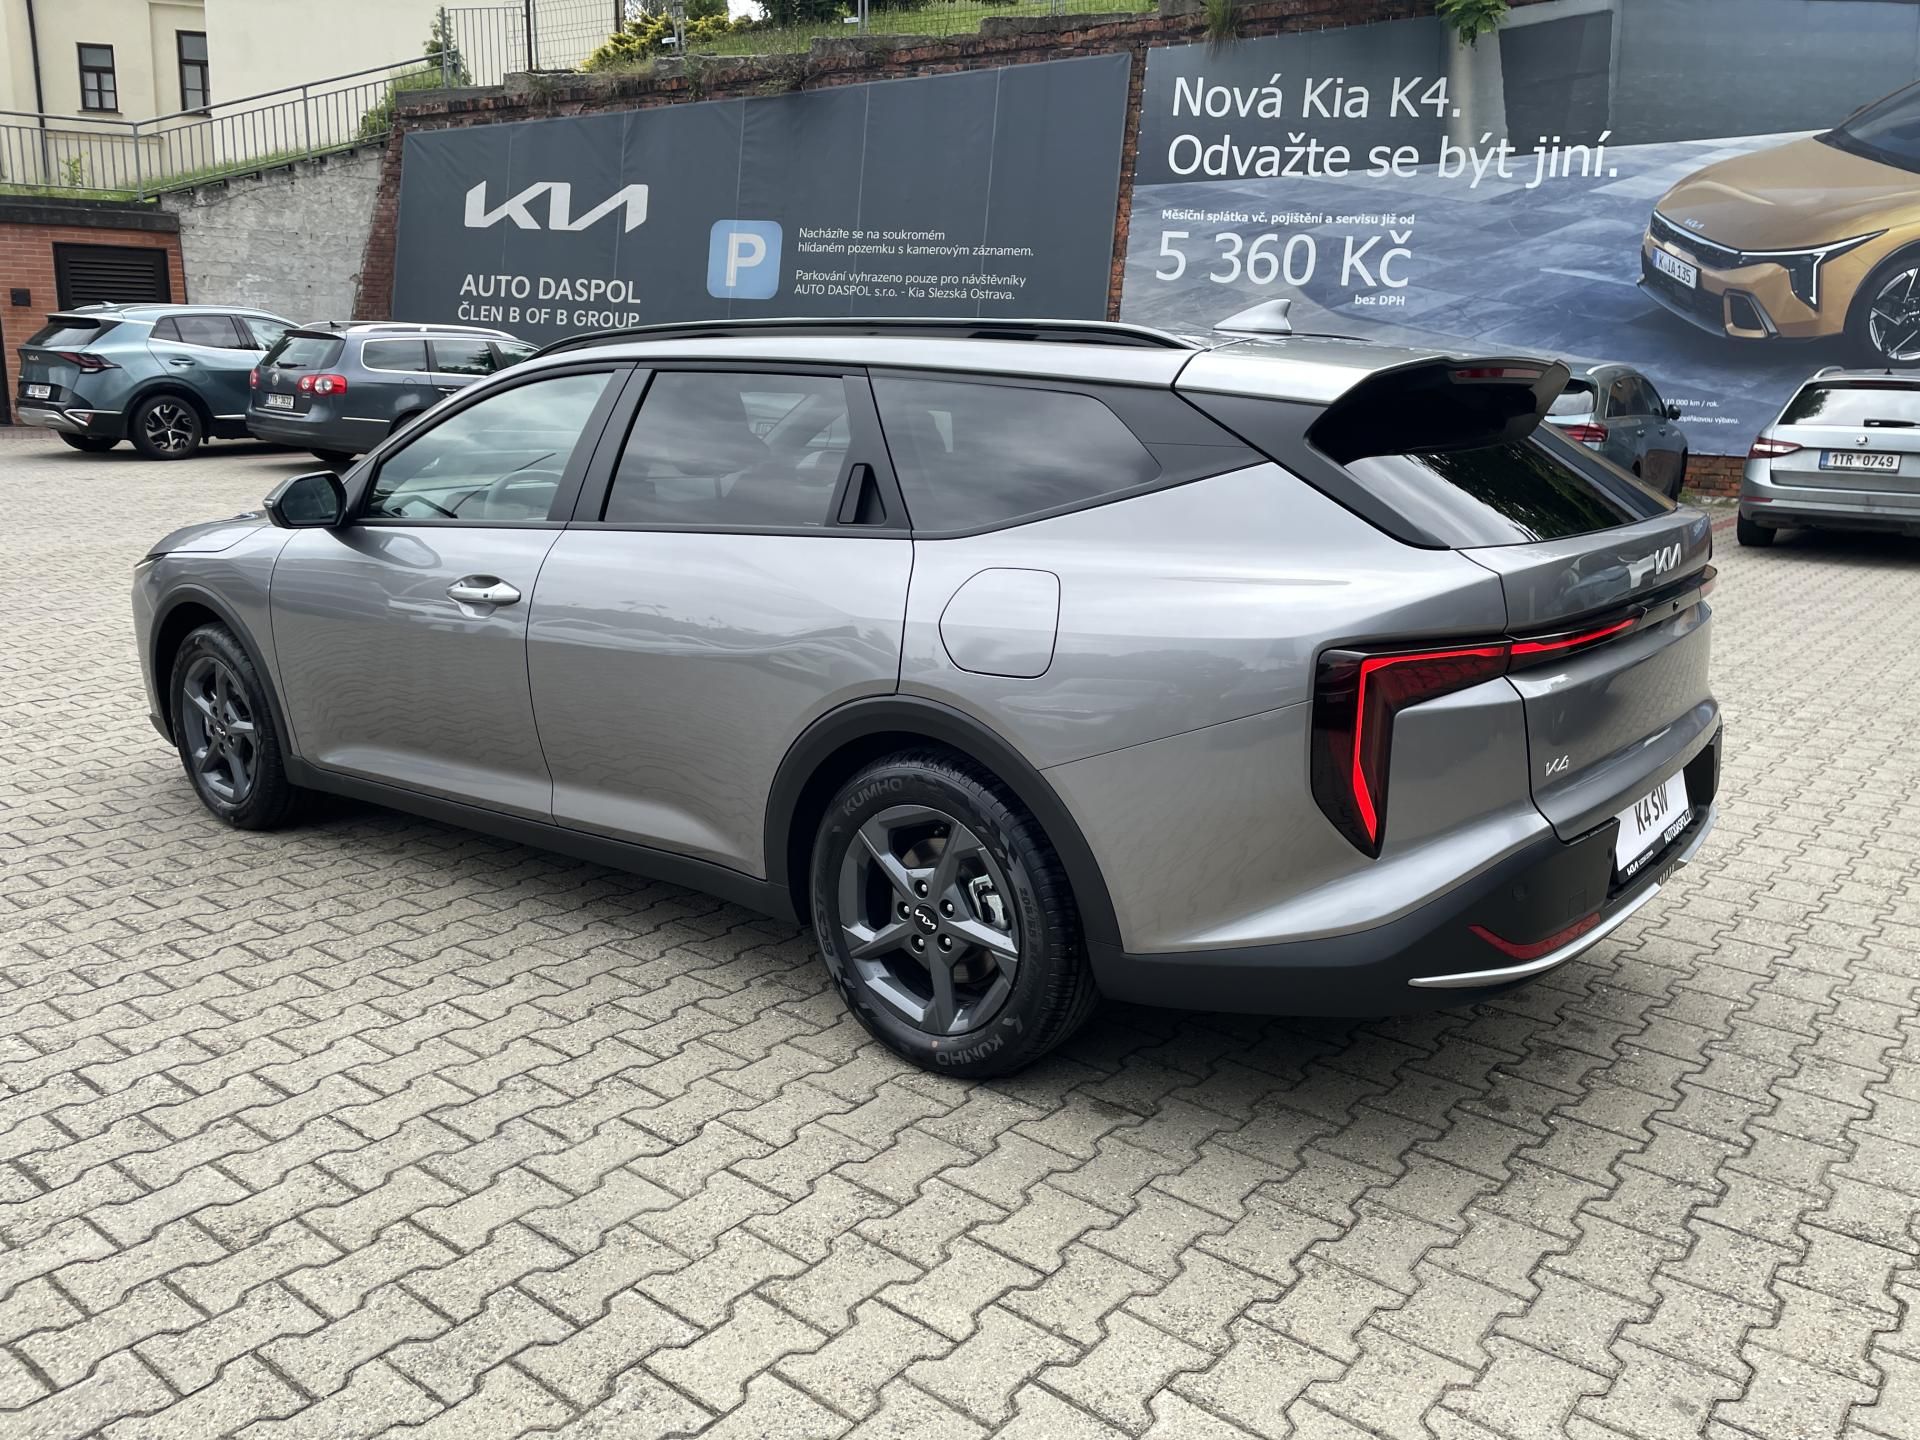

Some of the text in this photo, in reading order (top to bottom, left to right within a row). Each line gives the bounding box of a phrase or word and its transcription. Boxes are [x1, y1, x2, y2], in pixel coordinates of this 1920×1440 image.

[1172, 73, 1461, 118] Nová Kia K4.
[1168, 130, 1617, 189] Odvažte se být jiní.
[464, 180, 649, 233] KIA
[1162, 209, 1415, 226] Měsíční splátka vč. pojištění a servisu již od
[799, 227, 945, 240] Nacházíte se na soukromém
[726, 233, 766, 286] P
[798, 242, 1034, 258] hlídaném pozemku s kamerovým záznamem.
[1156, 230, 1412, 288] 5 360 Kč
[460, 274, 641, 304] AUTO DASPOL
[794, 284, 825, 294] AUTO
[828, 285, 871, 296] DASPOL
[874, 288, 898, 297] s.r.o.
[908, 287, 925, 297] Kia
[928, 287, 966, 299] Slezská
[970, 289, 1015, 300] Ostrava.
[795, 270, 1026, 288] Parkování vyhrazeno pouze pro návštěvníky
[1354, 294, 1405, 306] bez DPH
[458, 301, 640, 328] ČLEN B OF B GROUP
[1832, 454, 1894, 467] 1TR 0749
[843, 778, 902, 816] KUMHO
[1634, 783, 1668, 835] K4 SW
